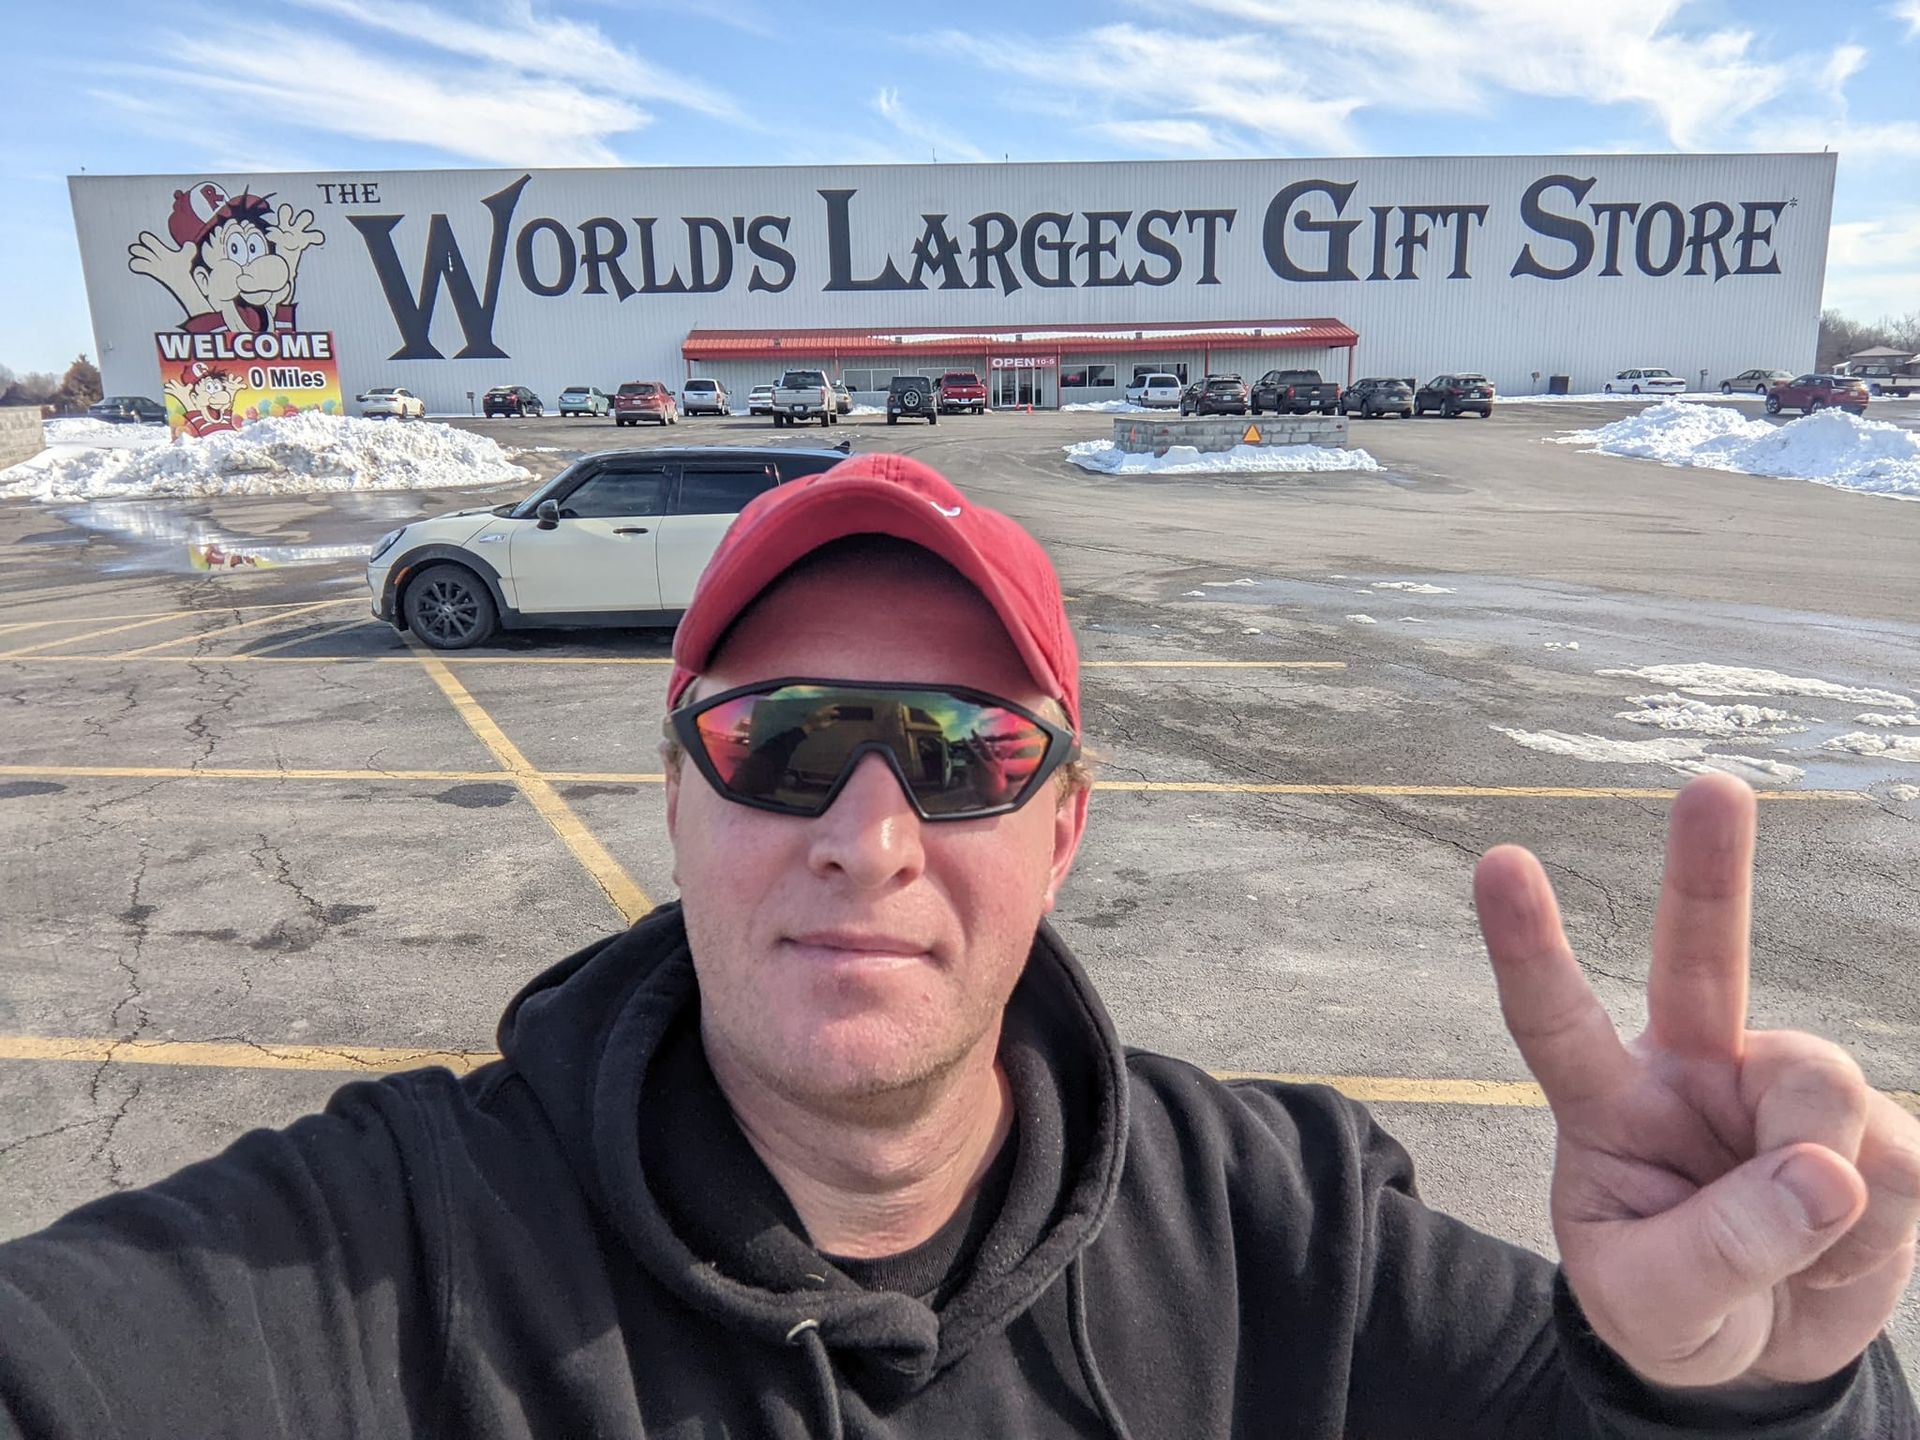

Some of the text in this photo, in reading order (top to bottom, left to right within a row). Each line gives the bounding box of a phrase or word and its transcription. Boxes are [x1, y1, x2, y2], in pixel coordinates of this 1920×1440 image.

[200, 185, 224, 211] R
[317, 182, 381, 204] THE
[346, 174, 796, 360] WORLD'S
[817, 189, 1238, 297] LARGEST
[1263, 179, 1490, 282] GIFT
[158, 334, 331, 359] WELCOME
[992, 358, 1035, 367] OPEN
[251, 368, 325, 388] 0 Miles
